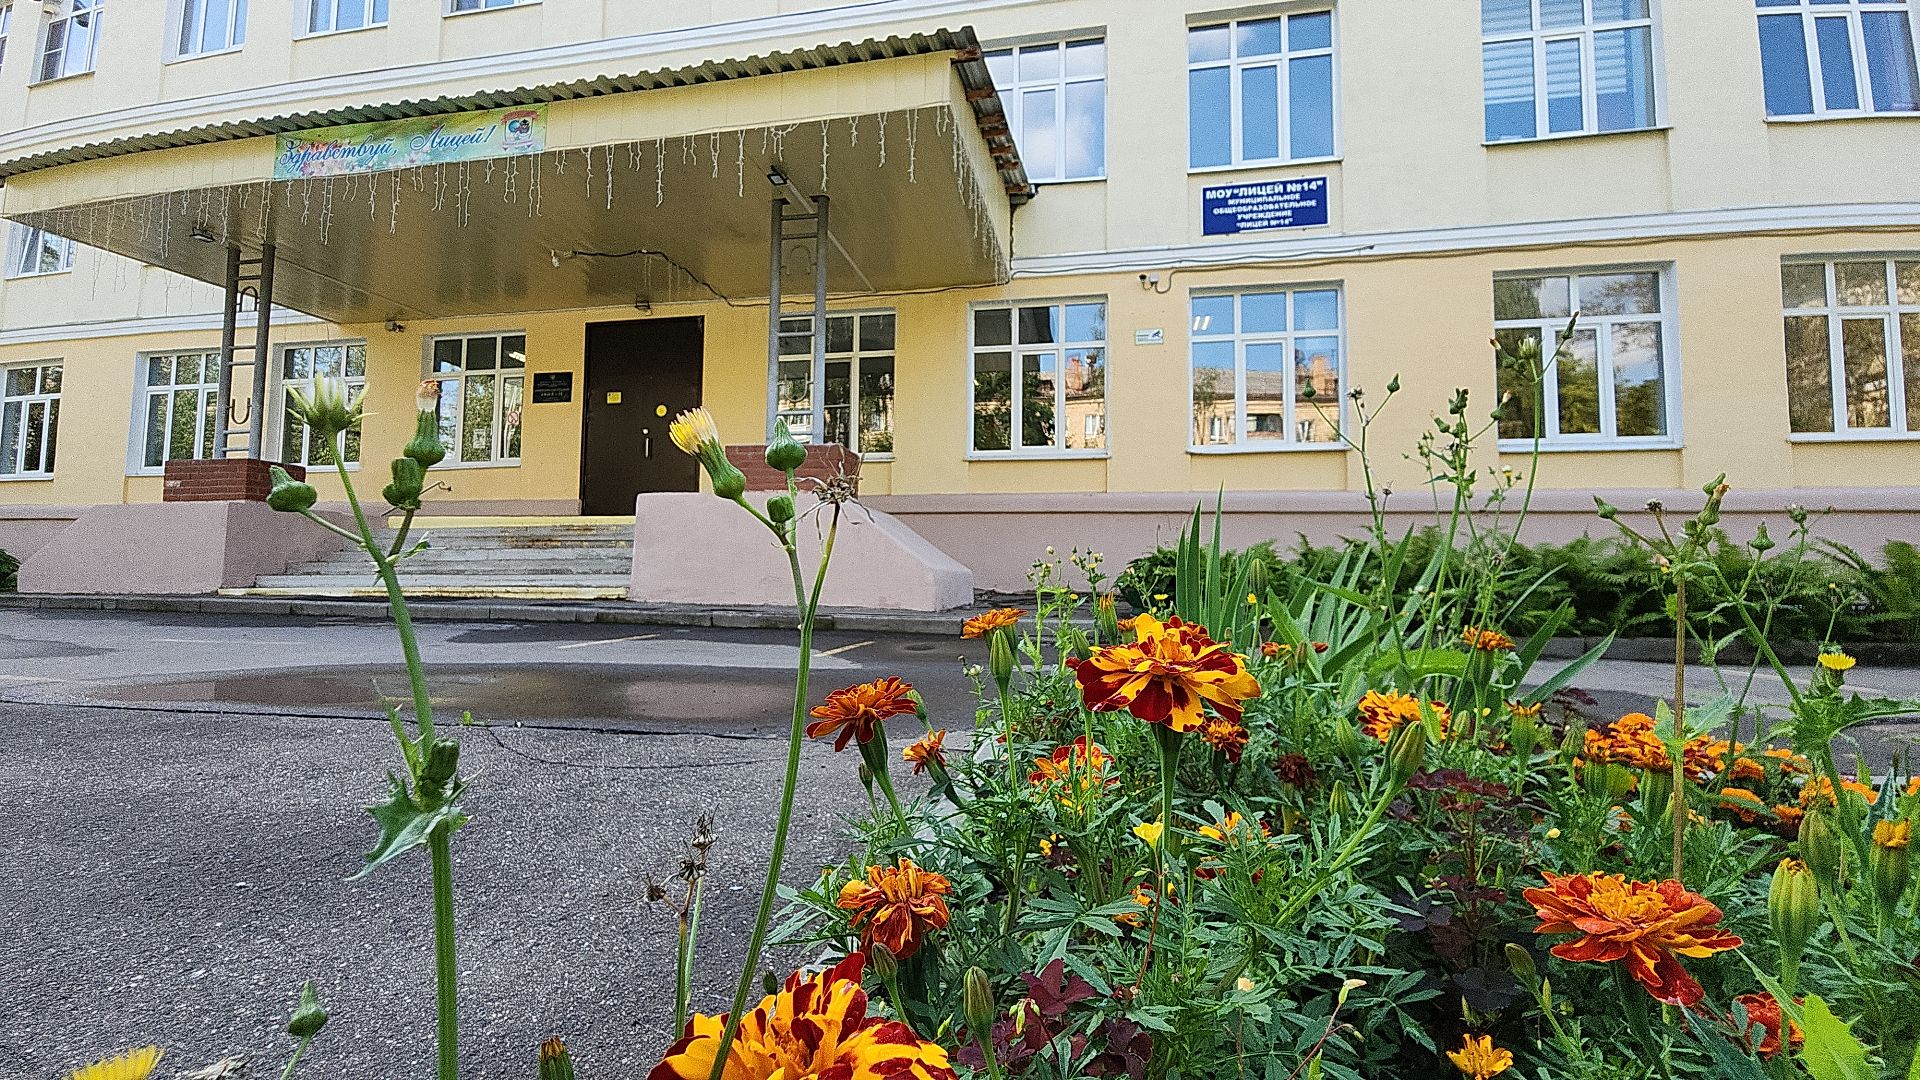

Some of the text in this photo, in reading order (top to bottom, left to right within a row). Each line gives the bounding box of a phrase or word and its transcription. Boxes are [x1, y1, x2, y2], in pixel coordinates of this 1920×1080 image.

[279, 123, 497, 173] Здравствуй, Лицей!
[1228, 193, 1301, 206] МУНИЦИПАЛЬНОЕ
[1212, 200, 1317, 215] ОБЩЕОБРАЗОВАТЕЛЬНОЕ
[1236, 209, 1293, 220] УЧРЕЖДЕНИЕ
